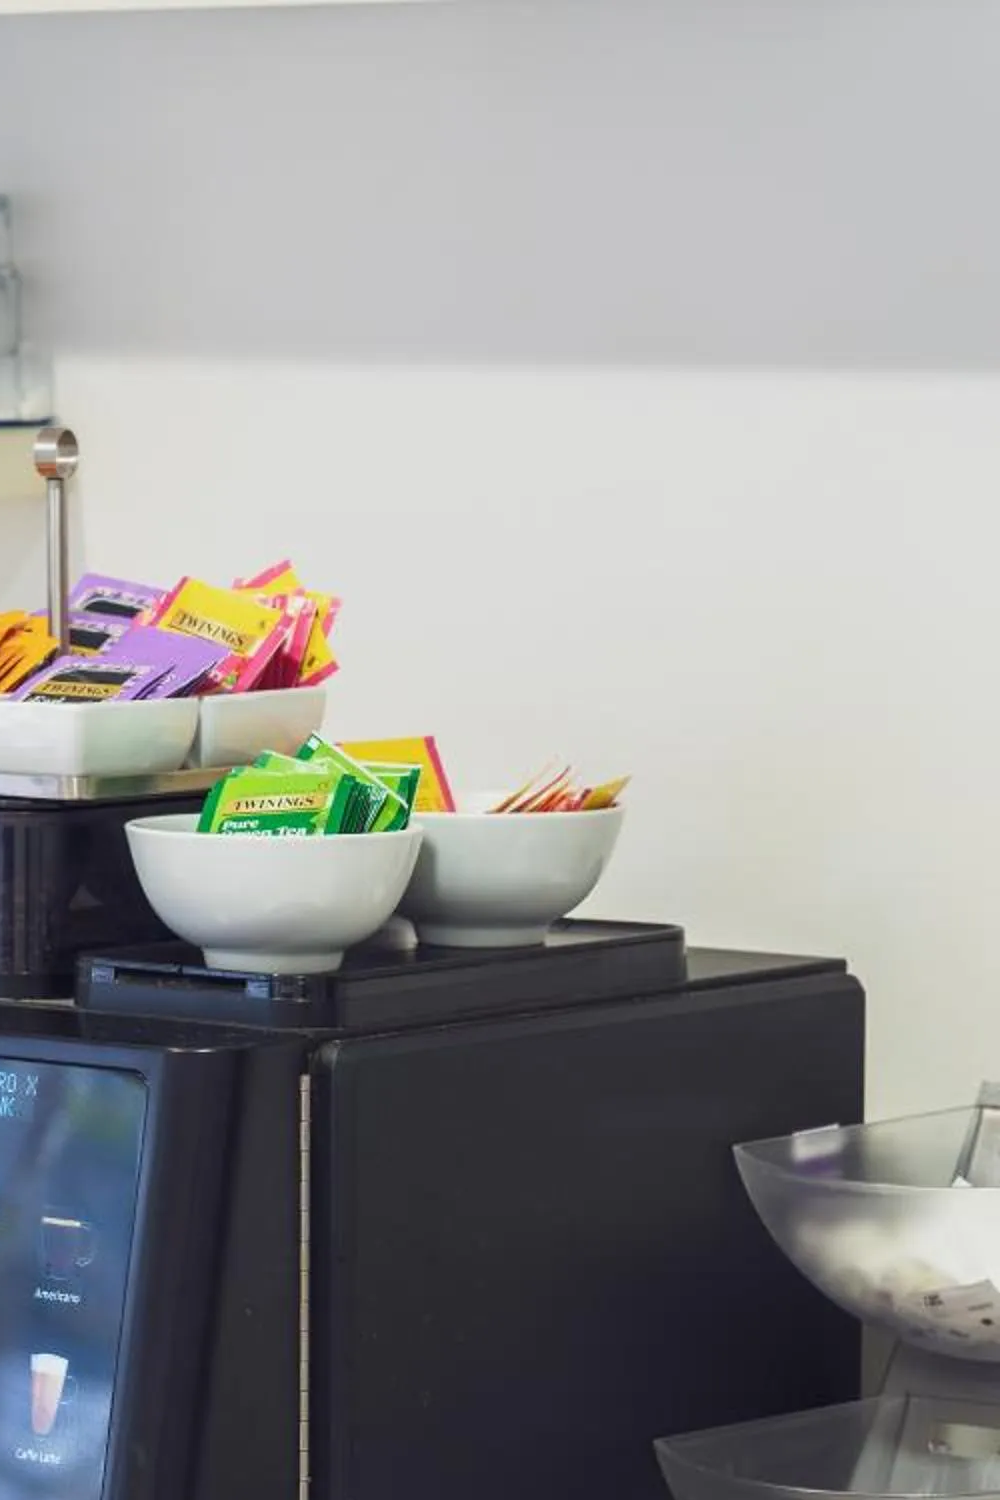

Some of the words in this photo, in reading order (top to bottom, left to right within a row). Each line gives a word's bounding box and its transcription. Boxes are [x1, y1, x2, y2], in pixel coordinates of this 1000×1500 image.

[177, 612, 245, 648] TWININGS
[41, 683, 110, 695] TWININGS
[233, 796, 315, 812] TWININGS
[24, 1074, 39, 1096] X
[33, 1286, 81, 1304] Americano
